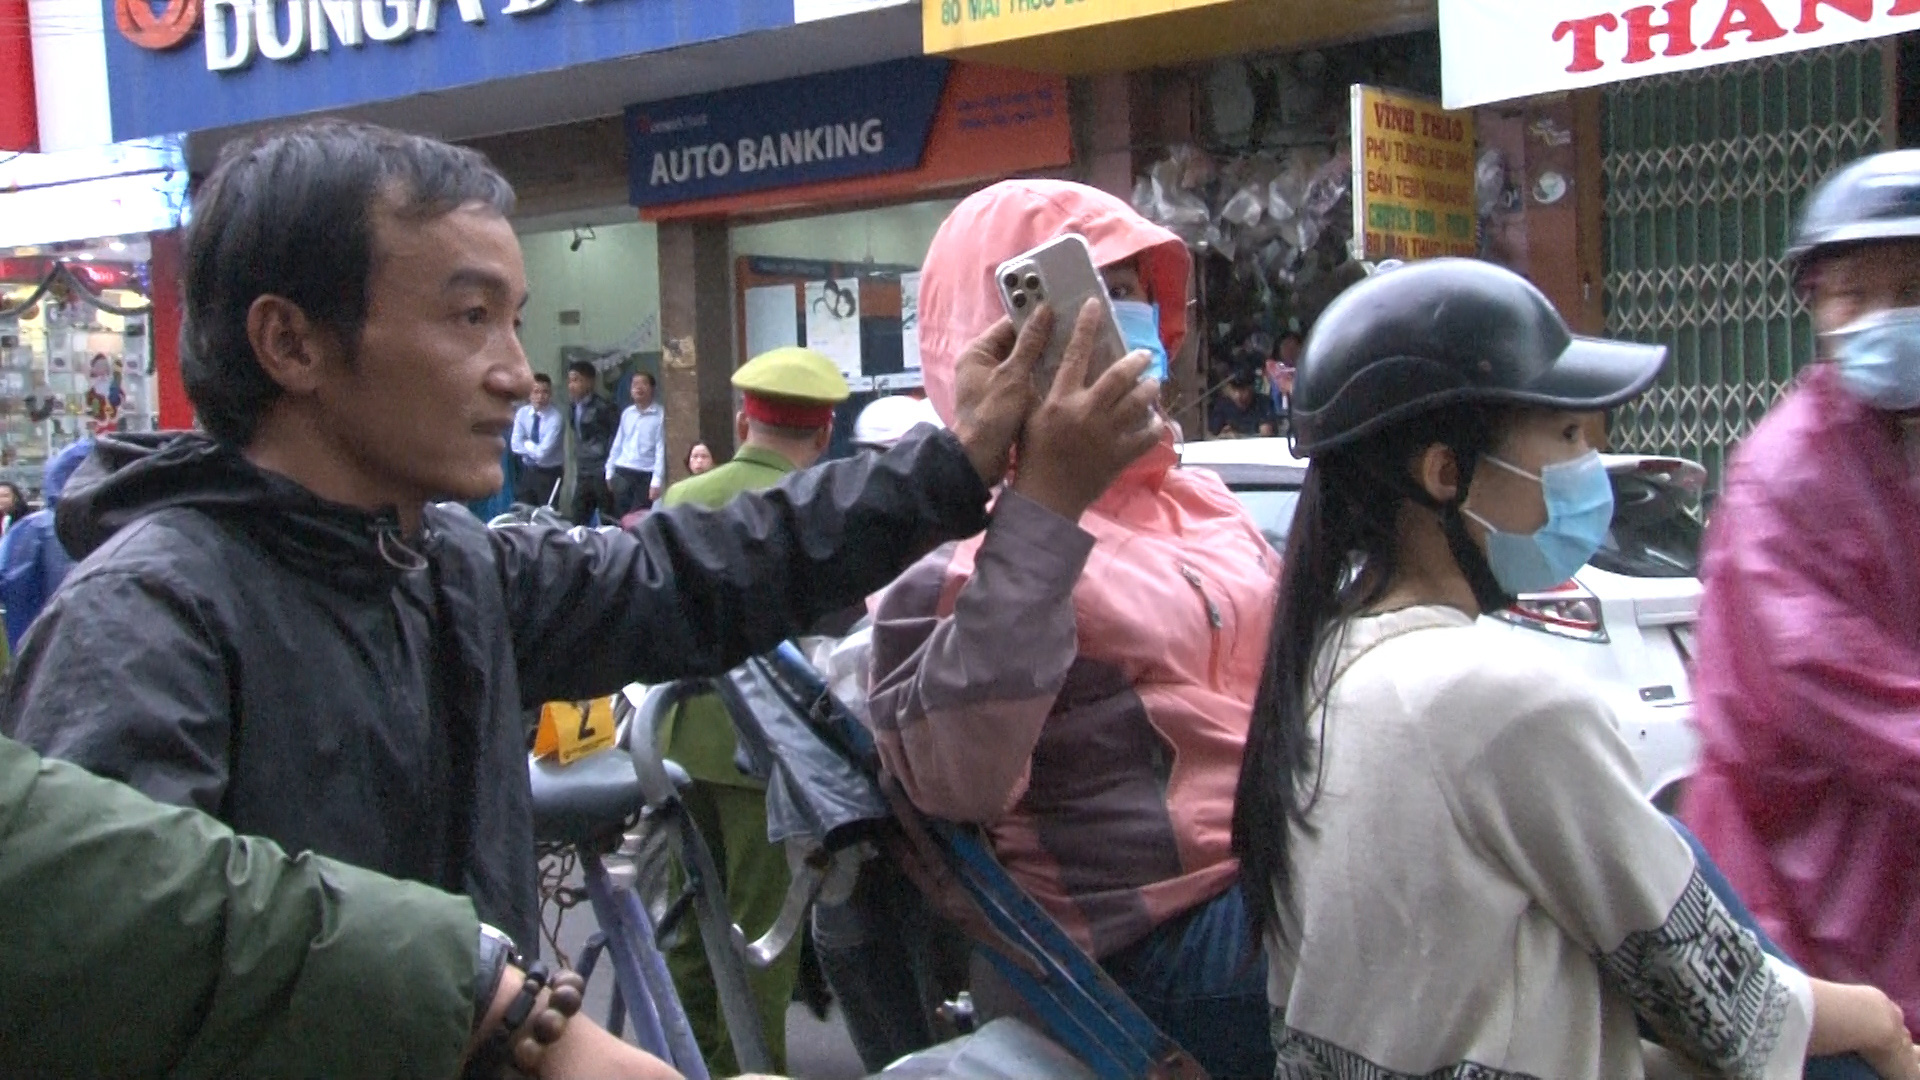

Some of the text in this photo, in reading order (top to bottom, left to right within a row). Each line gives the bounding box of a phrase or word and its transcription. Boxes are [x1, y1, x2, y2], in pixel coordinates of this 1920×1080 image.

[1551, 0, 1920, 73] THAN
[650, 143, 732, 186] AUTO
[738, 118, 884, 172] BANKING
